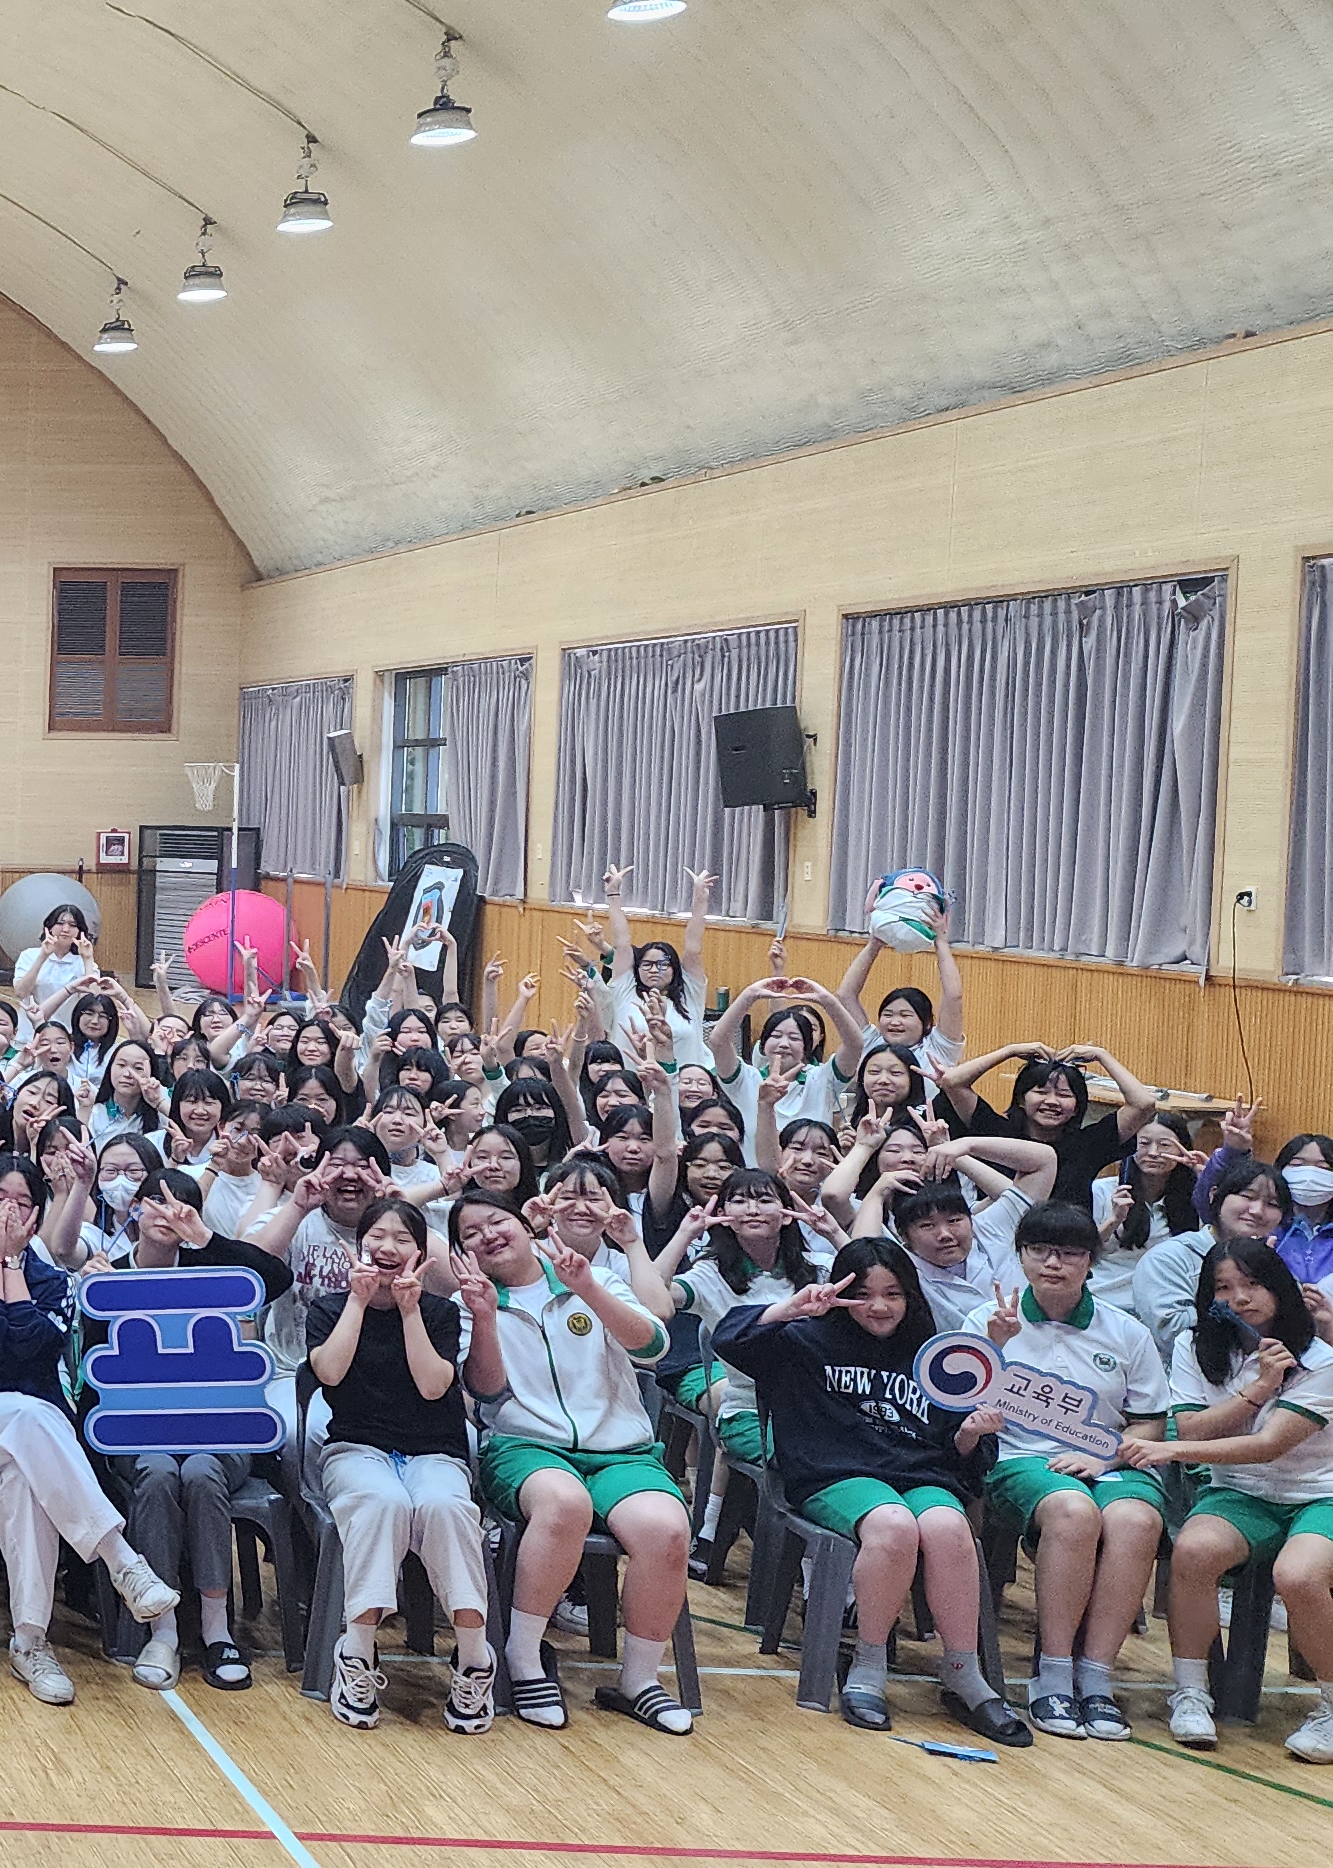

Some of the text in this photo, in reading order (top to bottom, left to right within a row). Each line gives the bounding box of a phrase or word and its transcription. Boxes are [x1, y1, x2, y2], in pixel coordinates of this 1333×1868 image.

[85, 1275, 279, 1447] 프
[824, 1365, 930, 1425] NEW YORK
[1004, 1372, 1084, 1416] 교육부
[995, 1398, 1111, 1449] Ministry of Education
